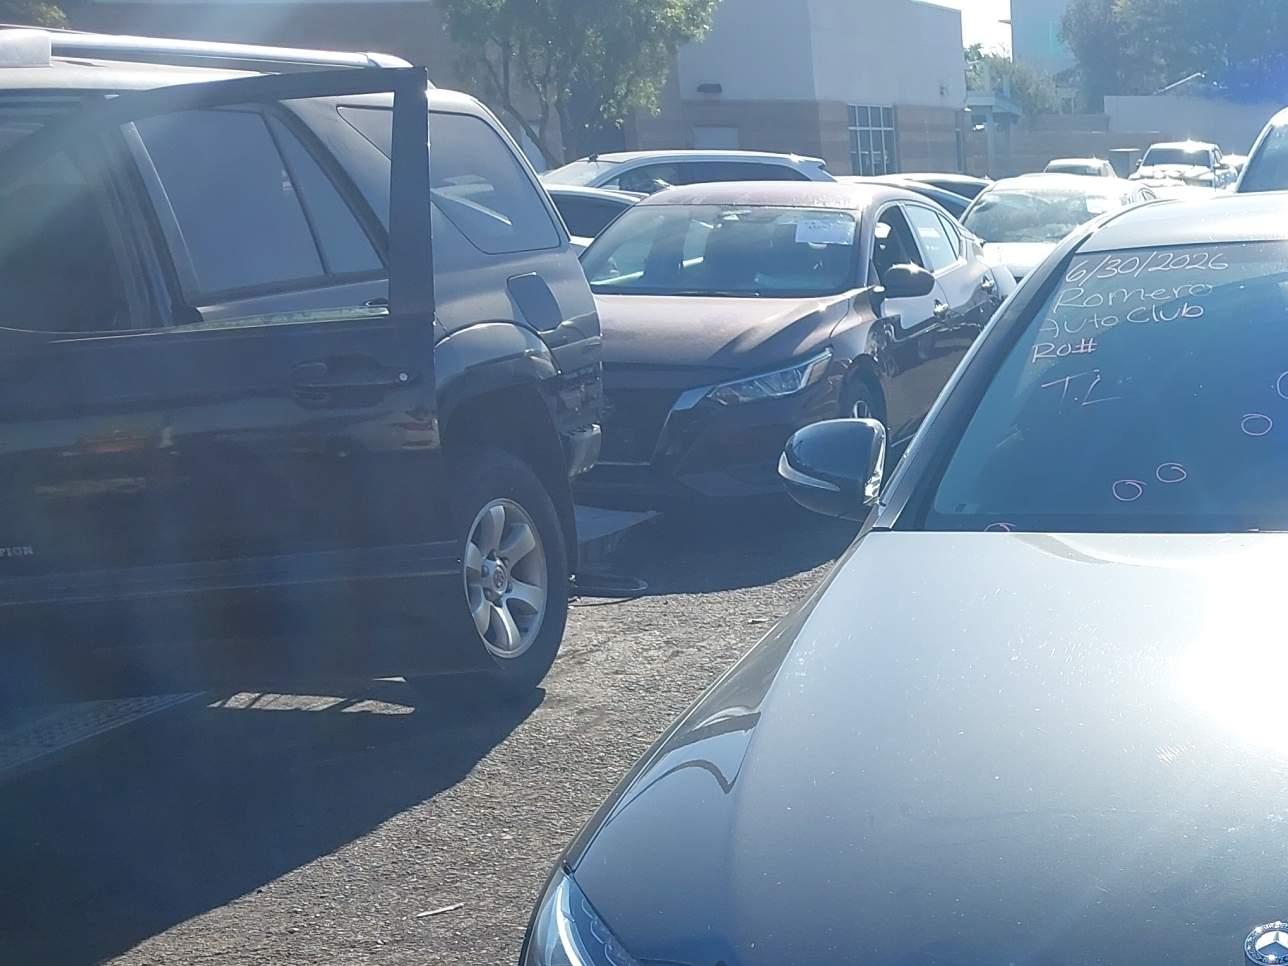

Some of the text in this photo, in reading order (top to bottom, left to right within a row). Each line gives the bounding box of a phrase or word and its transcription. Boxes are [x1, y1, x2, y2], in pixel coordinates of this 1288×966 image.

[1065, 251, 1228, 286] 6/30/2026
[1053, 284, 1213, 312] Romero
[1039, 302, 1204, 337] Auto Club
